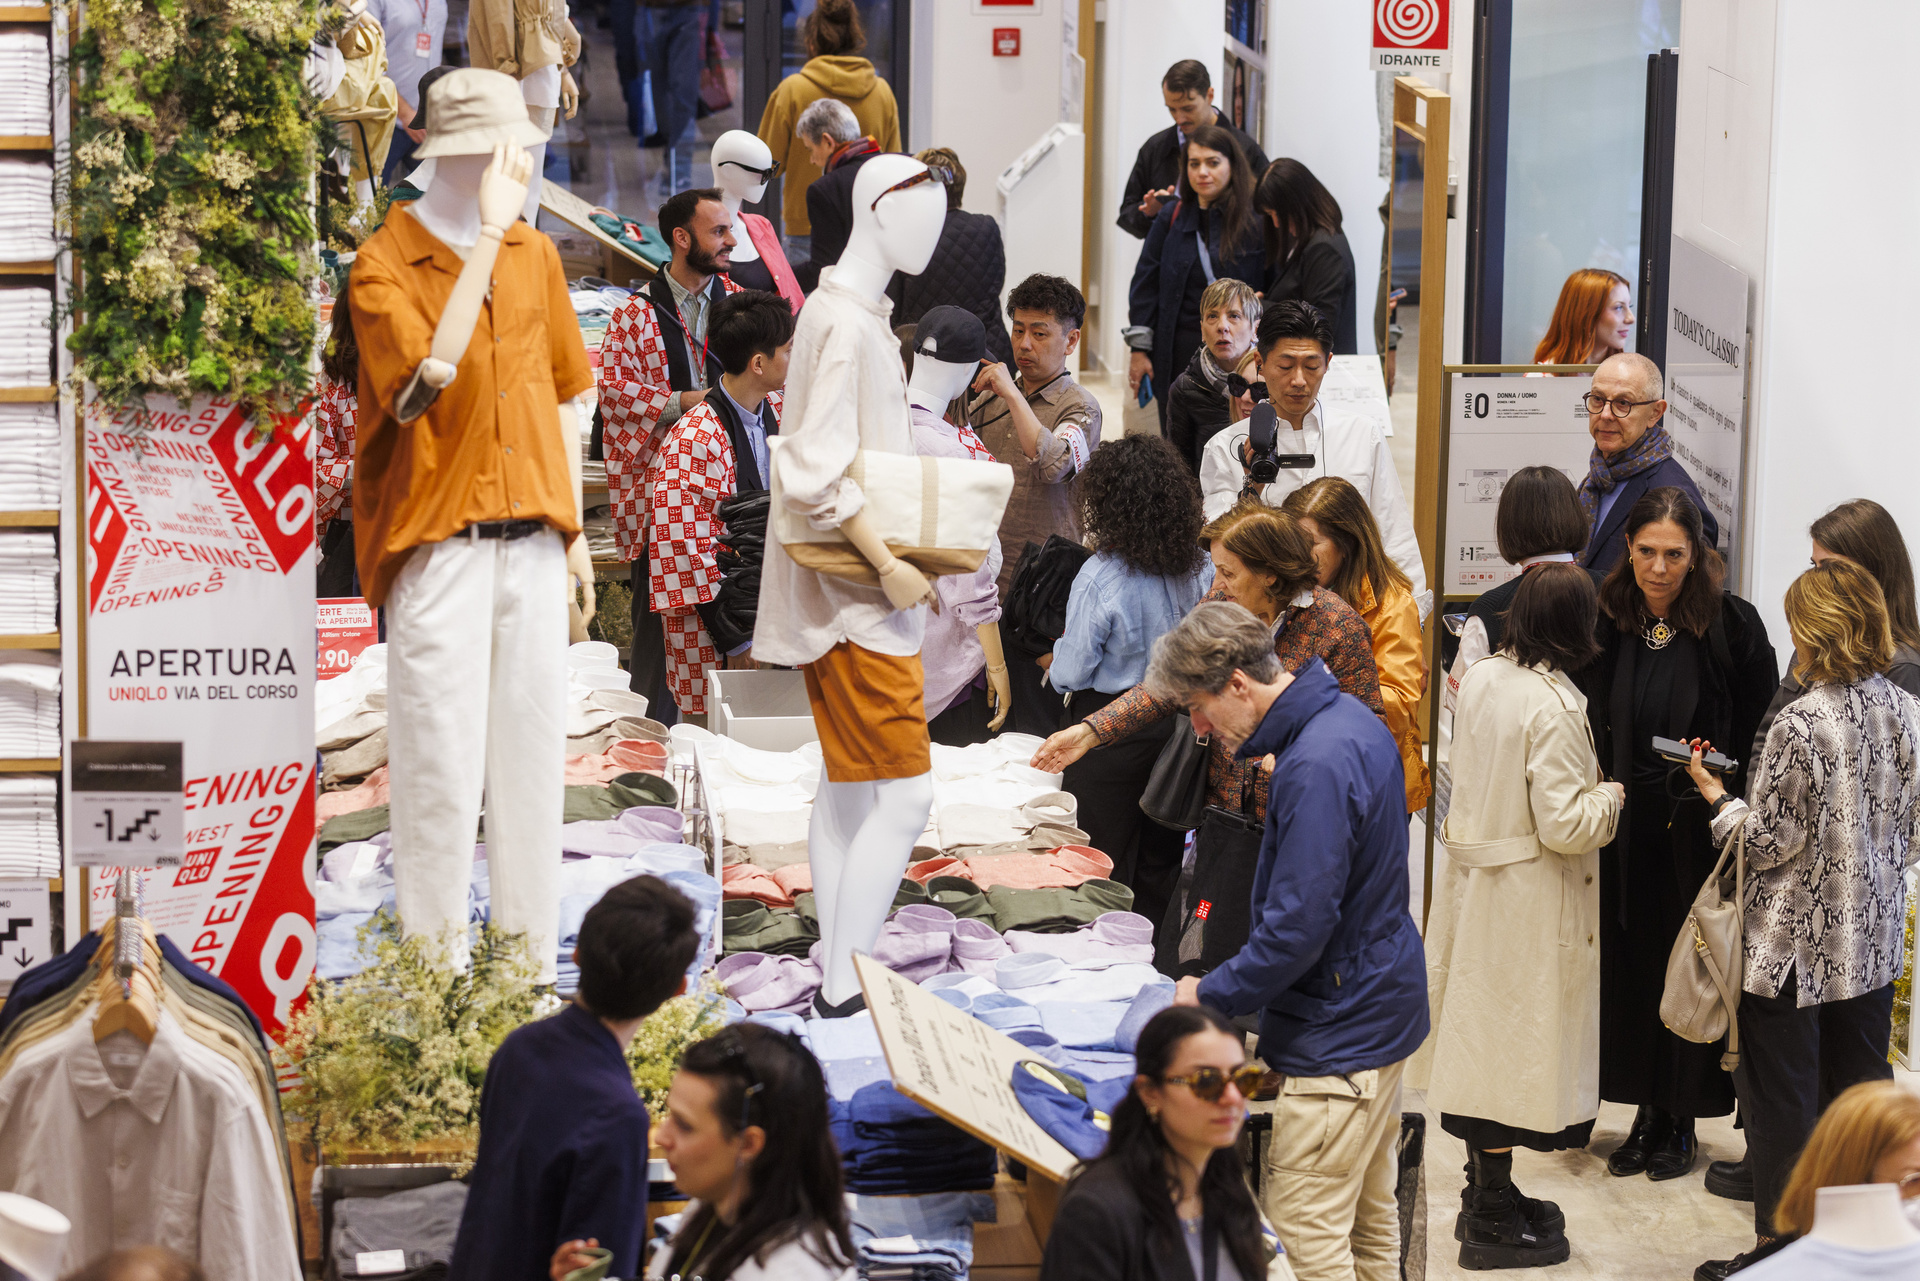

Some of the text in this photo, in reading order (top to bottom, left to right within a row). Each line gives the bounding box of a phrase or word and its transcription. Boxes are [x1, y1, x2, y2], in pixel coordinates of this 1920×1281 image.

[1380, 54, 1441, 67] IDRANTE
[1673, 307, 1739, 369] TODAY'S CLASSIC
[1464, 392, 1473, 418] PIANO
[1475, 393, 1489, 419] 0
[130, 473, 172, 487] UNIQLO
[148, 463, 195, 479] NEWEST
[137, 485, 174, 499] STORE
[192, 503, 216, 515] THE
[176, 512, 223, 527] NEWEST
[203, 469, 277, 573] OPENING
[141, 537, 252, 569] OPENING
[100, 582, 201, 613] OPENING
[329, 617, 368, 625] APERTURA
[110, 647, 296, 678] APERTURA
[109, 684, 298, 703] UNIQLO VIA DEL CORSO
[94, 808, 113, 841] -1
[186, 851, 215, 867] UNI
[178, 865, 211, 884] QLO
